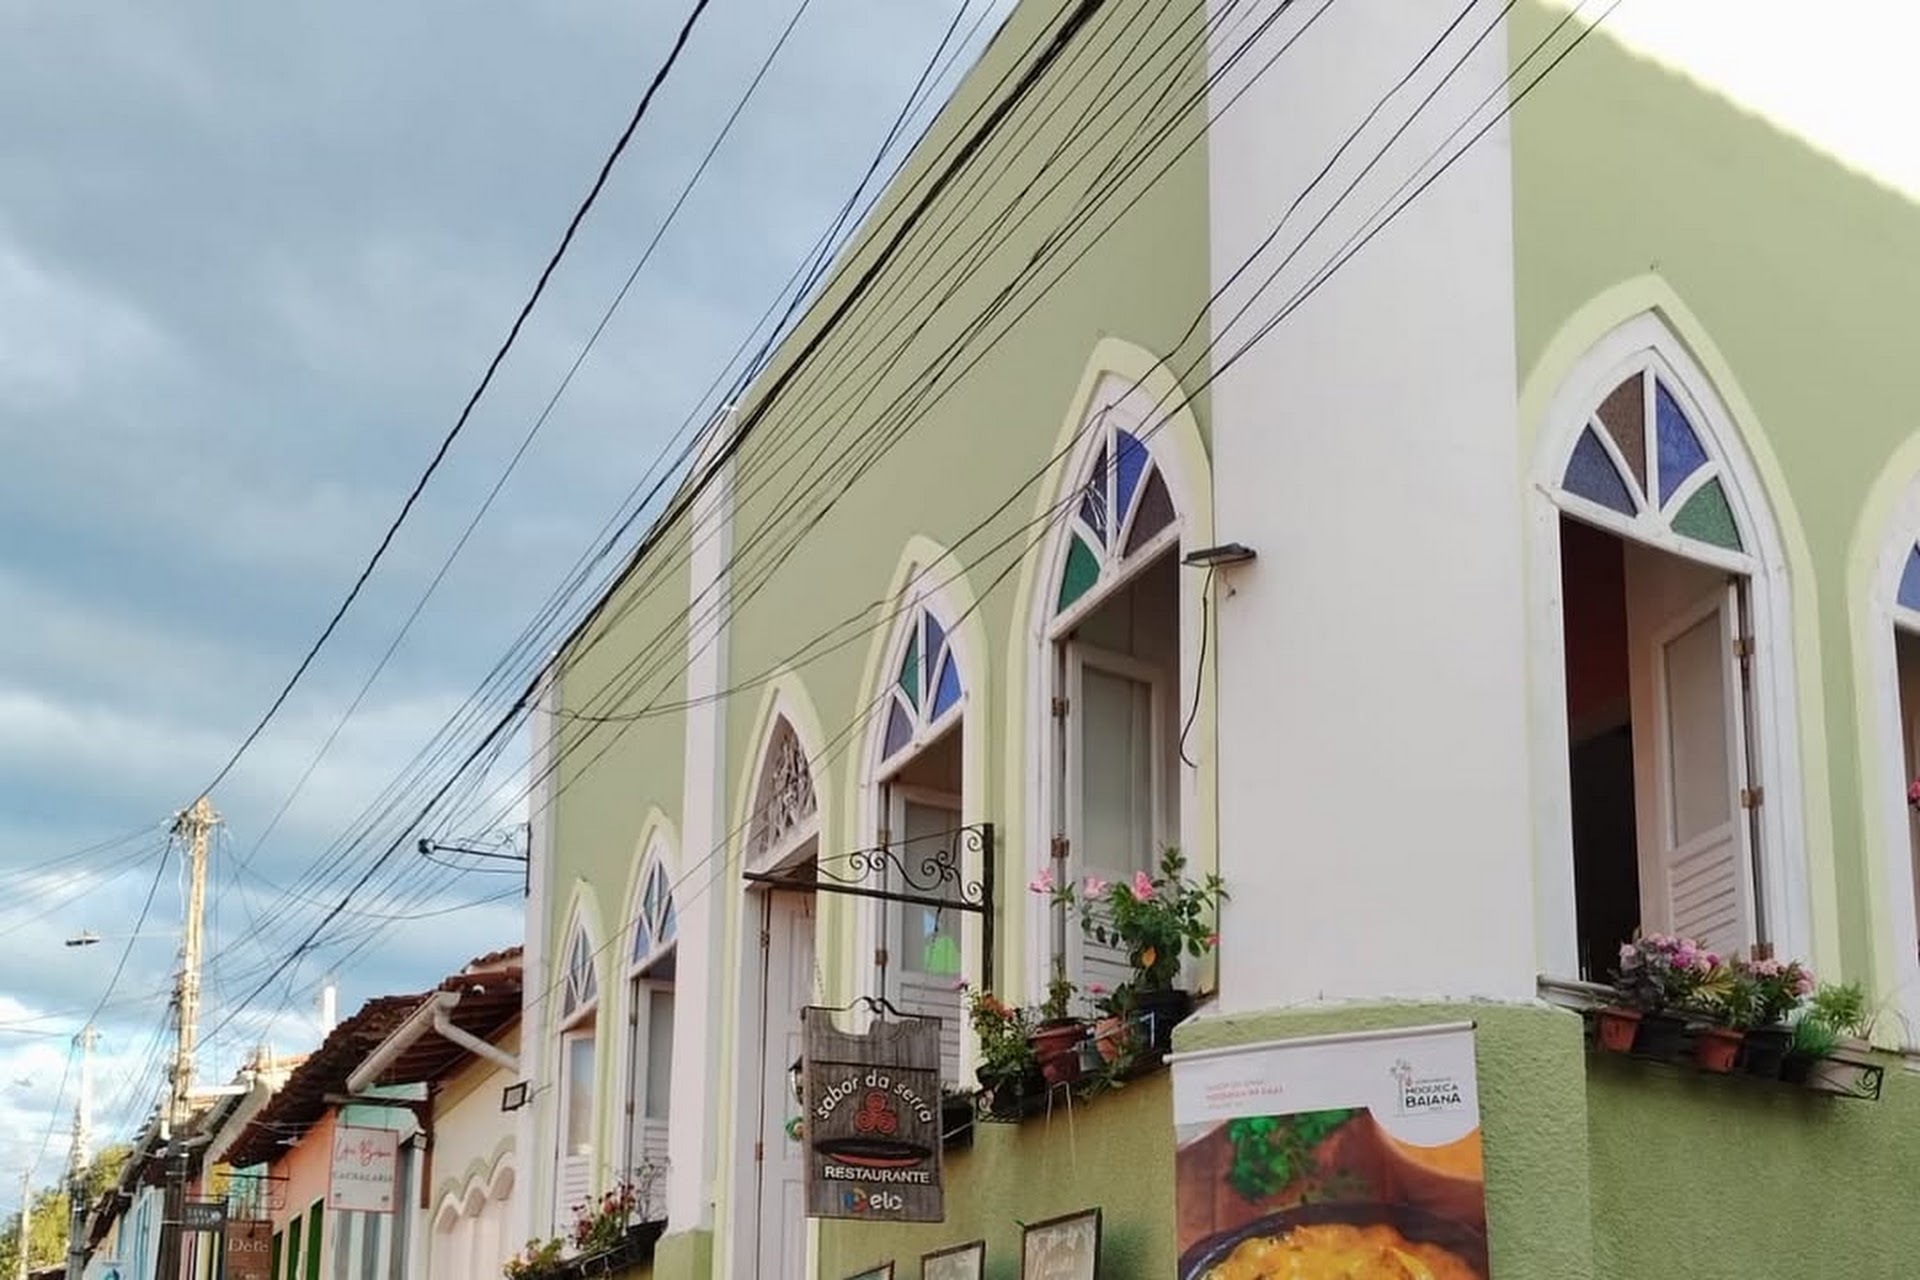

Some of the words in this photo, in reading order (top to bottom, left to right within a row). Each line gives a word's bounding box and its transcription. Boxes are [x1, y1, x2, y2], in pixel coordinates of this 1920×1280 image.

[817, 1075, 859, 1119] sabor
[865, 1070, 890, 1089] da
[893, 1082, 933, 1123] serra
[1405, 1092, 1462, 1108] BAIANA
[824, 1166, 931, 1183] RESTAURANTE
[869, 1191, 903, 1210] elo
